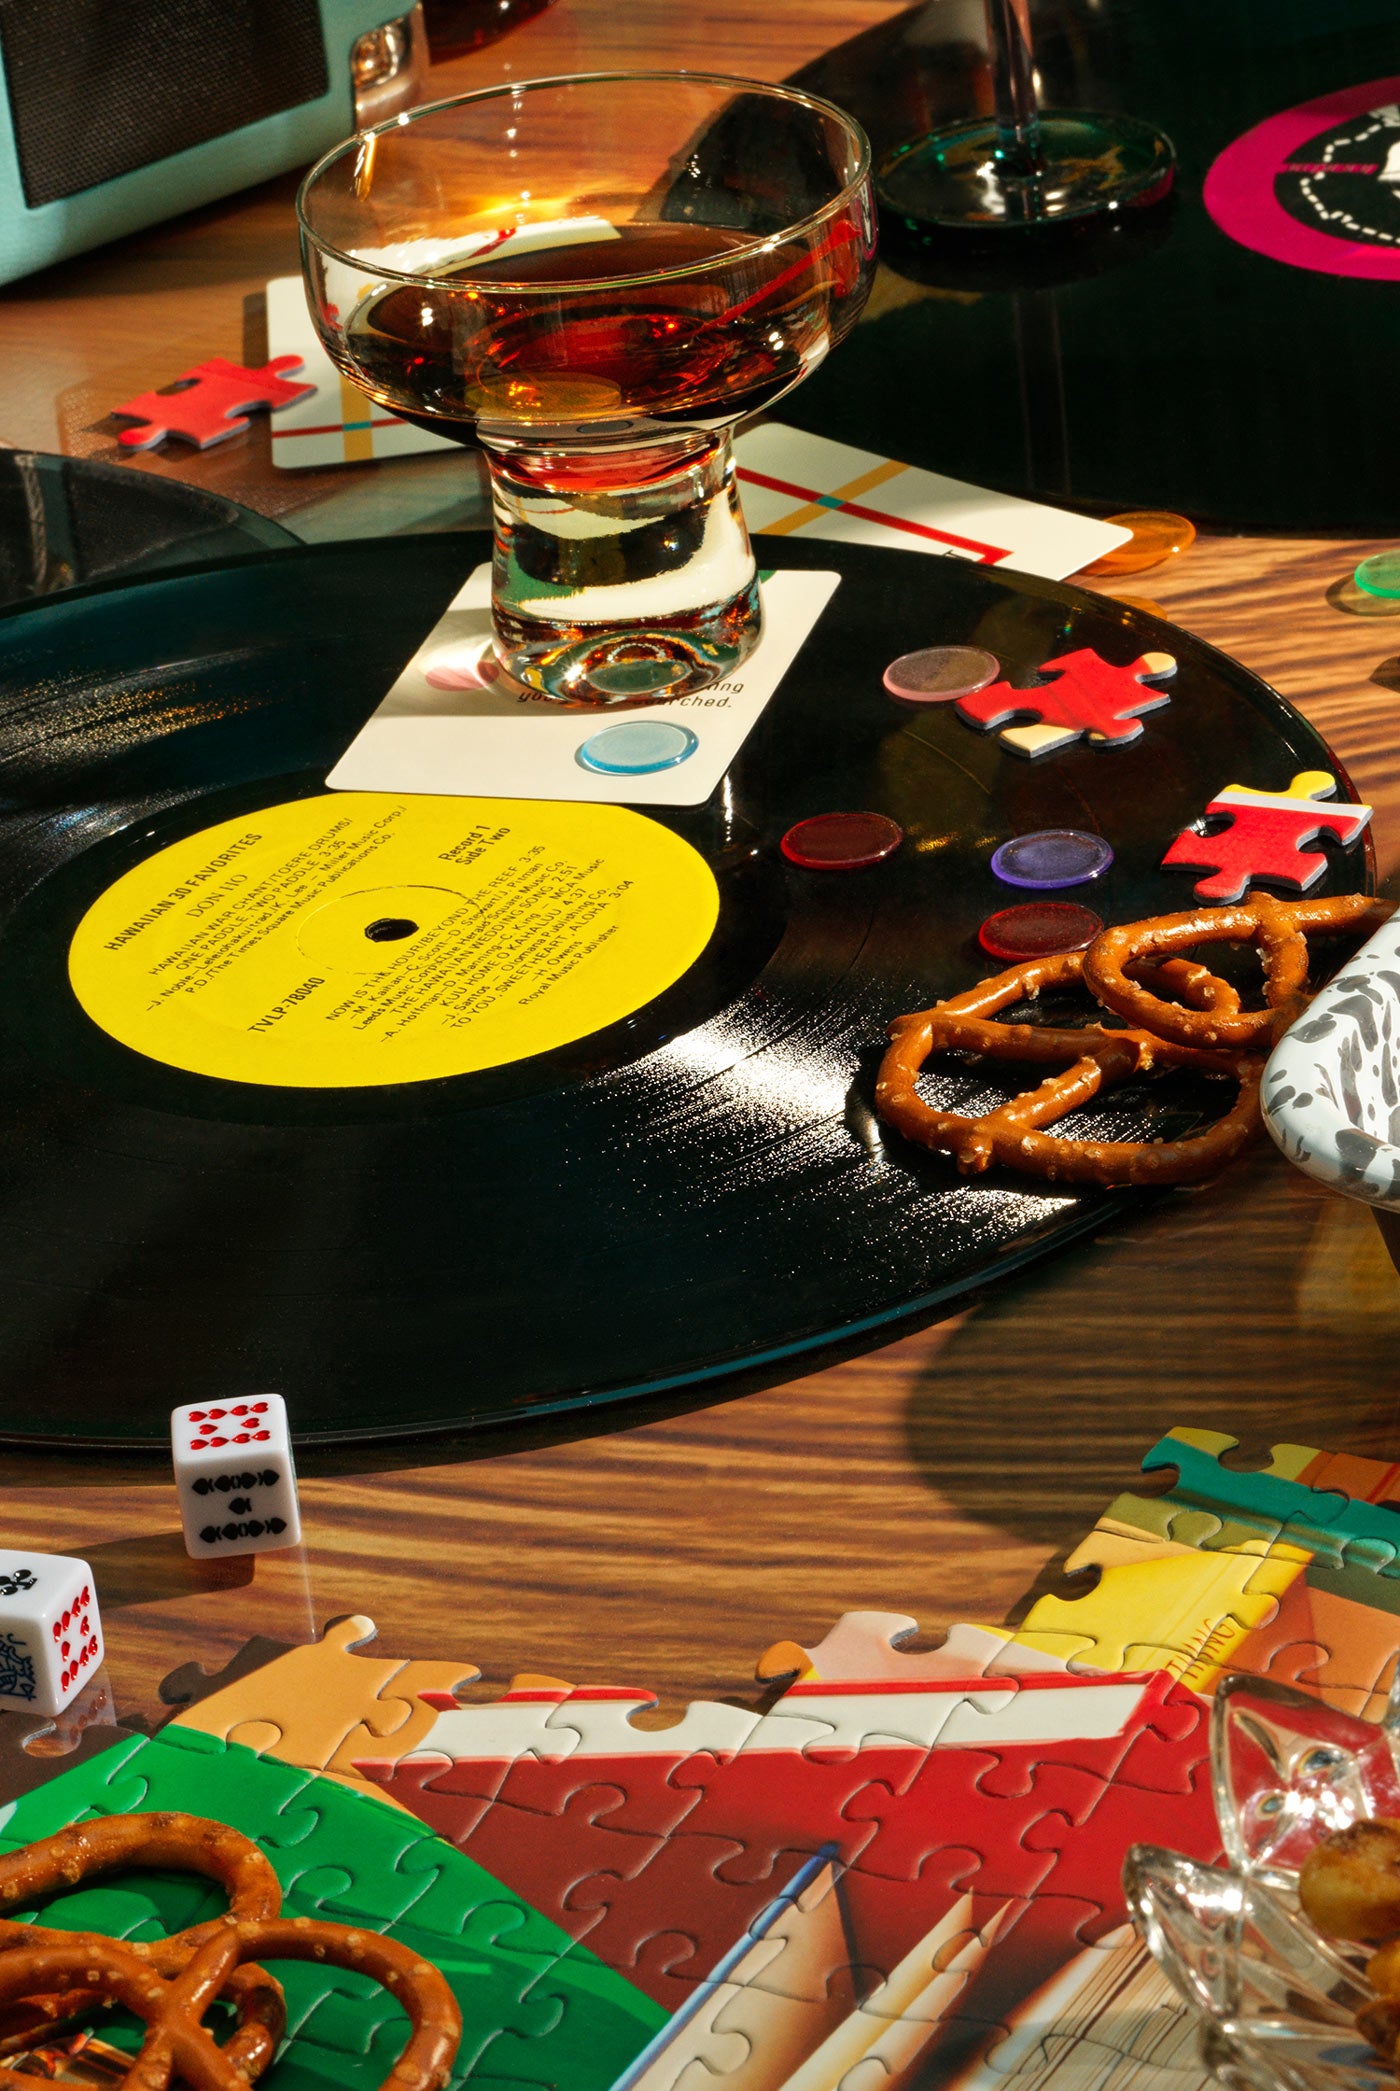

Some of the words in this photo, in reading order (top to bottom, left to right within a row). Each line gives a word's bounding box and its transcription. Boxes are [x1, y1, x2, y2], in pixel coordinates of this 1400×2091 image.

[285, 885, 308, 898] Lee
[318, 851, 350, 871] Miller
[346, 830, 379, 850] Music
[437, 831, 483, 861] Record
[455, 847, 487, 865] Side
[478, 827, 511, 845] Two
[506, 863, 543, 888] Pitman
[103, 900, 176, 951] HAWAIIAN
[168, 887, 192, 900] 30
[184, 833, 263, 887] FAVORITES
[176, 952, 204, 970] ONE
[246, 894, 276, 911] TWO
[272, 860, 320, 893] PADDLE
[185, 892, 226, 918] DON
[226, 936, 262, 957] Times
[257, 910, 295, 935] Square
[289, 888, 323, 909] Music
[317, 845, 378, 887] Publications
[372, 833, 395, 844] Co.
[512, 913, 541, 930] King
[549, 882, 578, 900] MCA
[573, 859, 605, 880] Music
[148, 932, 210, 975] HAWAIIAN
[205, 911, 236, 930] WAR
[325, 1000, 356, 1021] NOW
[352, 990, 368, 998] IS
[362, 971, 392, 987] THE
[488, 866, 517, 888] REEF
[352, 1008, 387, 1030] Leeds
[380, 985, 414, 1007] Music
[456, 919, 491, 945] Herald
[486, 895, 523, 919] Square
[518, 873, 550, 894] Music
[389, 996, 419, 1013] THE
[414, 950, 474, 995] HAWAIIAN
[469, 910, 524, 949] WEDDING
[519, 886, 554, 908] SONG
[439, 987, 467, 1007] KUU
[464, 960, 501, 986] HOME
[506, 909, 562, 951] KAHALUU
[450, 1017, 472, 1028] TO
[569, 903, 610, 932] ALOHA
[453, 986, 491, 1011] Santos
[501, 939, 546, 971] Olomana
[541, 901, 595, 937] Publishing
[588, 888, 610, 900] Co.
[518, 982, 552, 1005] Royal
[546, 960, 579, 982] Music
[573, 925, 619, 959] Publisher
[546, 941, 583, 965] Owens
[247, 977, 325, 1032] TVLP-78040
